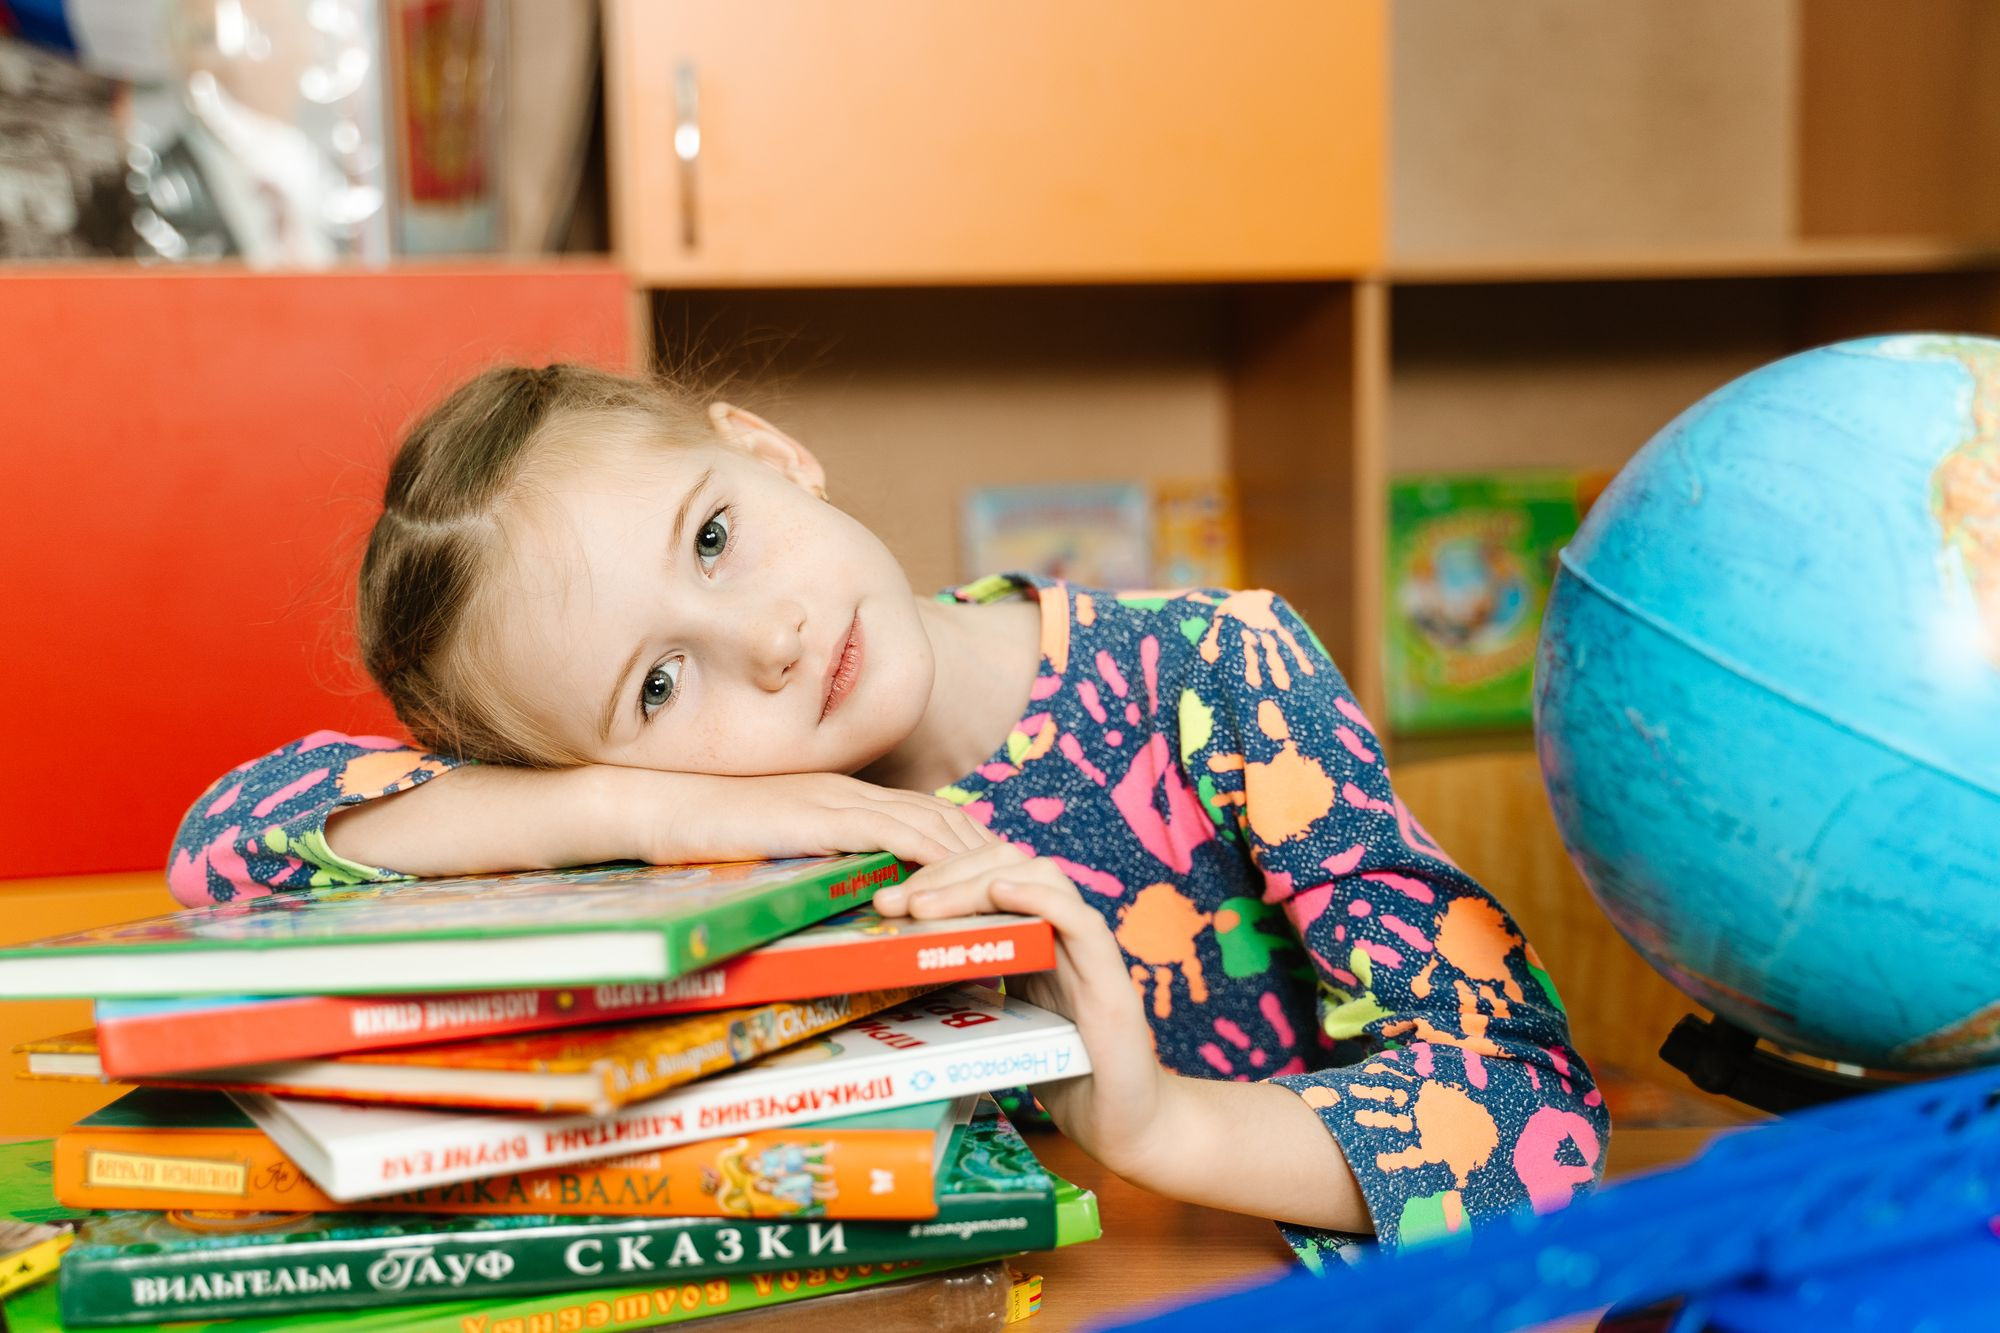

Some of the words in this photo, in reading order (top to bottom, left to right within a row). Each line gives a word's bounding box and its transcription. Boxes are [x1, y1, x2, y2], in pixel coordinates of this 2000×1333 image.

[353, 1002, 423, 1038] СТИХИ
[424, 990, 539, 1030] ЛЮБИМЫЕ
[699, 1076, 893, 1128] ПРИКЛЮЧЕНИЯ
[546, 1114, 684, 1152] КАПИТАНА
[382, 1137, 529, 1180] ВРУНГЕЛЯ
[559, 1174, 674, 1205] ВАЛИ
[132, 1263, 351, 1306] ВИЛЬГЕЛЬМ
[564, 1223, 848, 1275] СКАЗКИ
